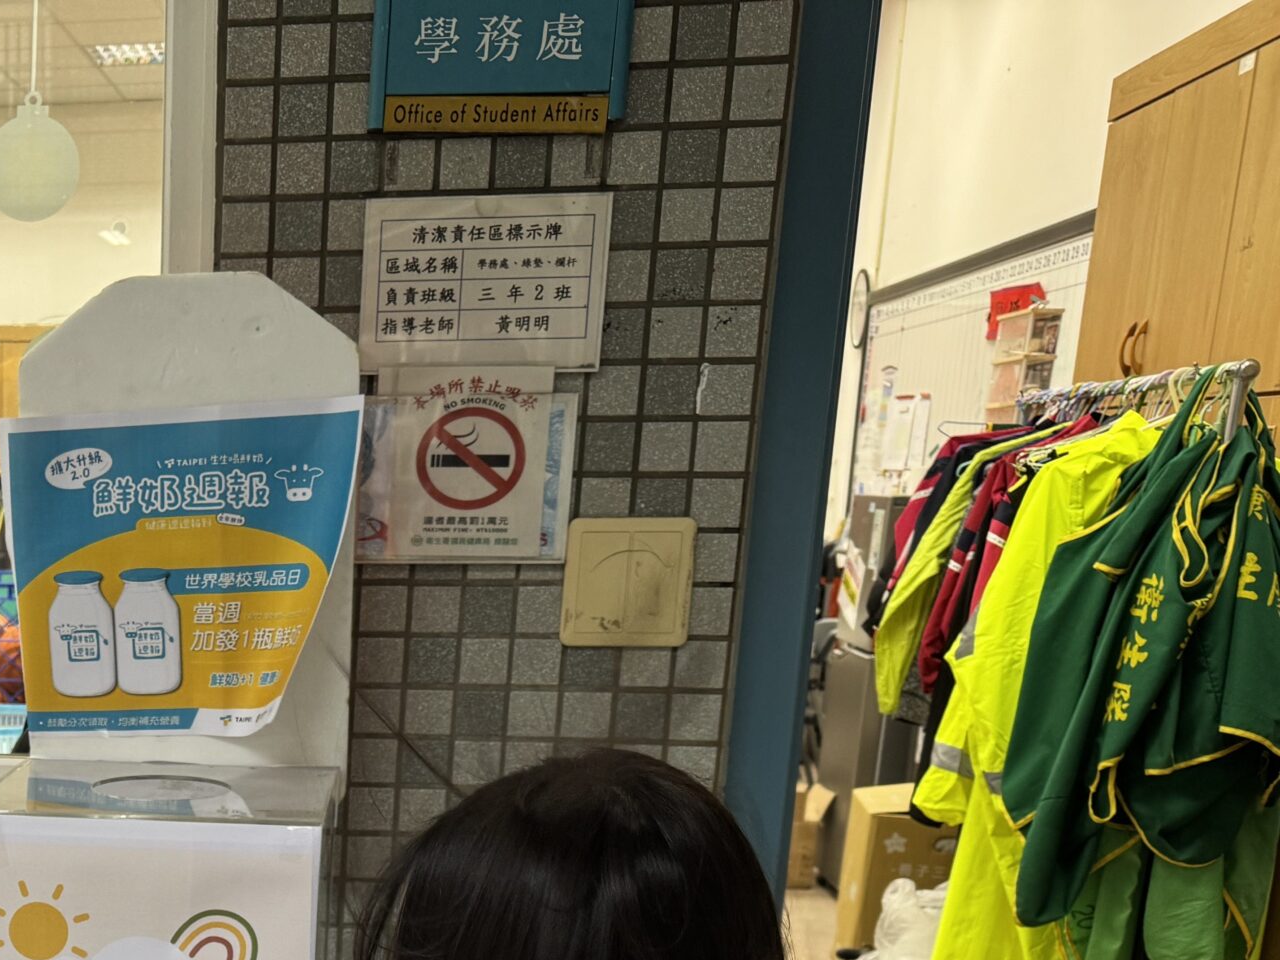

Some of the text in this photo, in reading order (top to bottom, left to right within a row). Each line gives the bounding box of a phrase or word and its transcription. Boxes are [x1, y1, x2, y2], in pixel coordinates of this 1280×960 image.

[414, 12, 585, 63] 學務處
[393, 103, 599, 124] Office of Student Affairs
[412, 222, 563, 244] 清潔責任區標示牌
[386, 255, 458, 275] 區域名稱
[384, 288, 457, 307] 負責班級
[381, 315, 550, 336] 指導老師 黃明明
[444, 397, 507, 411] NO SMOKING
[50, 450, 103, 476] 擴大升級
[177, 458, 207, 466] TAIPEI
[71, 468, 90, 481] 2.0
[92, 469, 270, 518] 鮮奶週報
[185, 568, 301, 589] 世界學校乳品日
[193, 601, 241, 624] 當週
